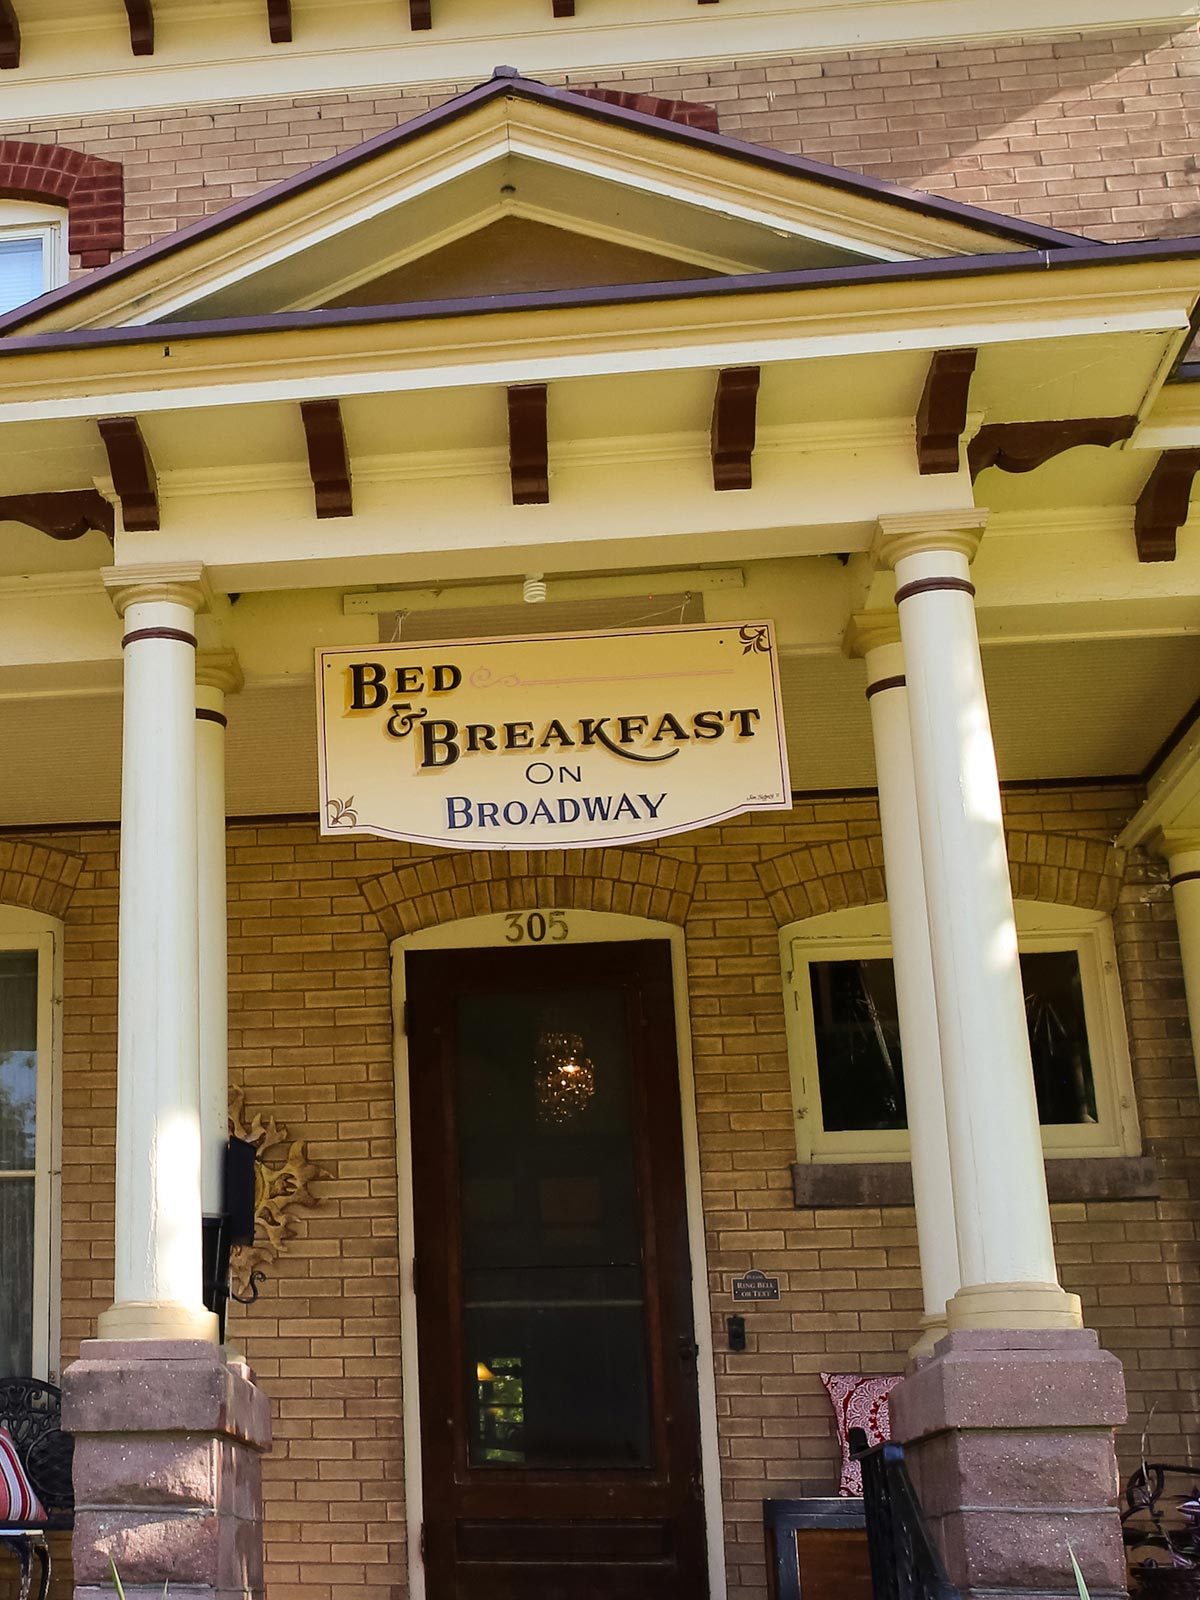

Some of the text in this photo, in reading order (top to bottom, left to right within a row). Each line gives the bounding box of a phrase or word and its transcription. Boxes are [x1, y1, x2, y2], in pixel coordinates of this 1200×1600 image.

[348, 662, 462, 710] BED
[386, 703, 761, 768] & BREAKFAST
[525, 762, 582, 785] ON
[446, 793, 668, 830] BROADWAY
[504, 911, 568, 942] 305
